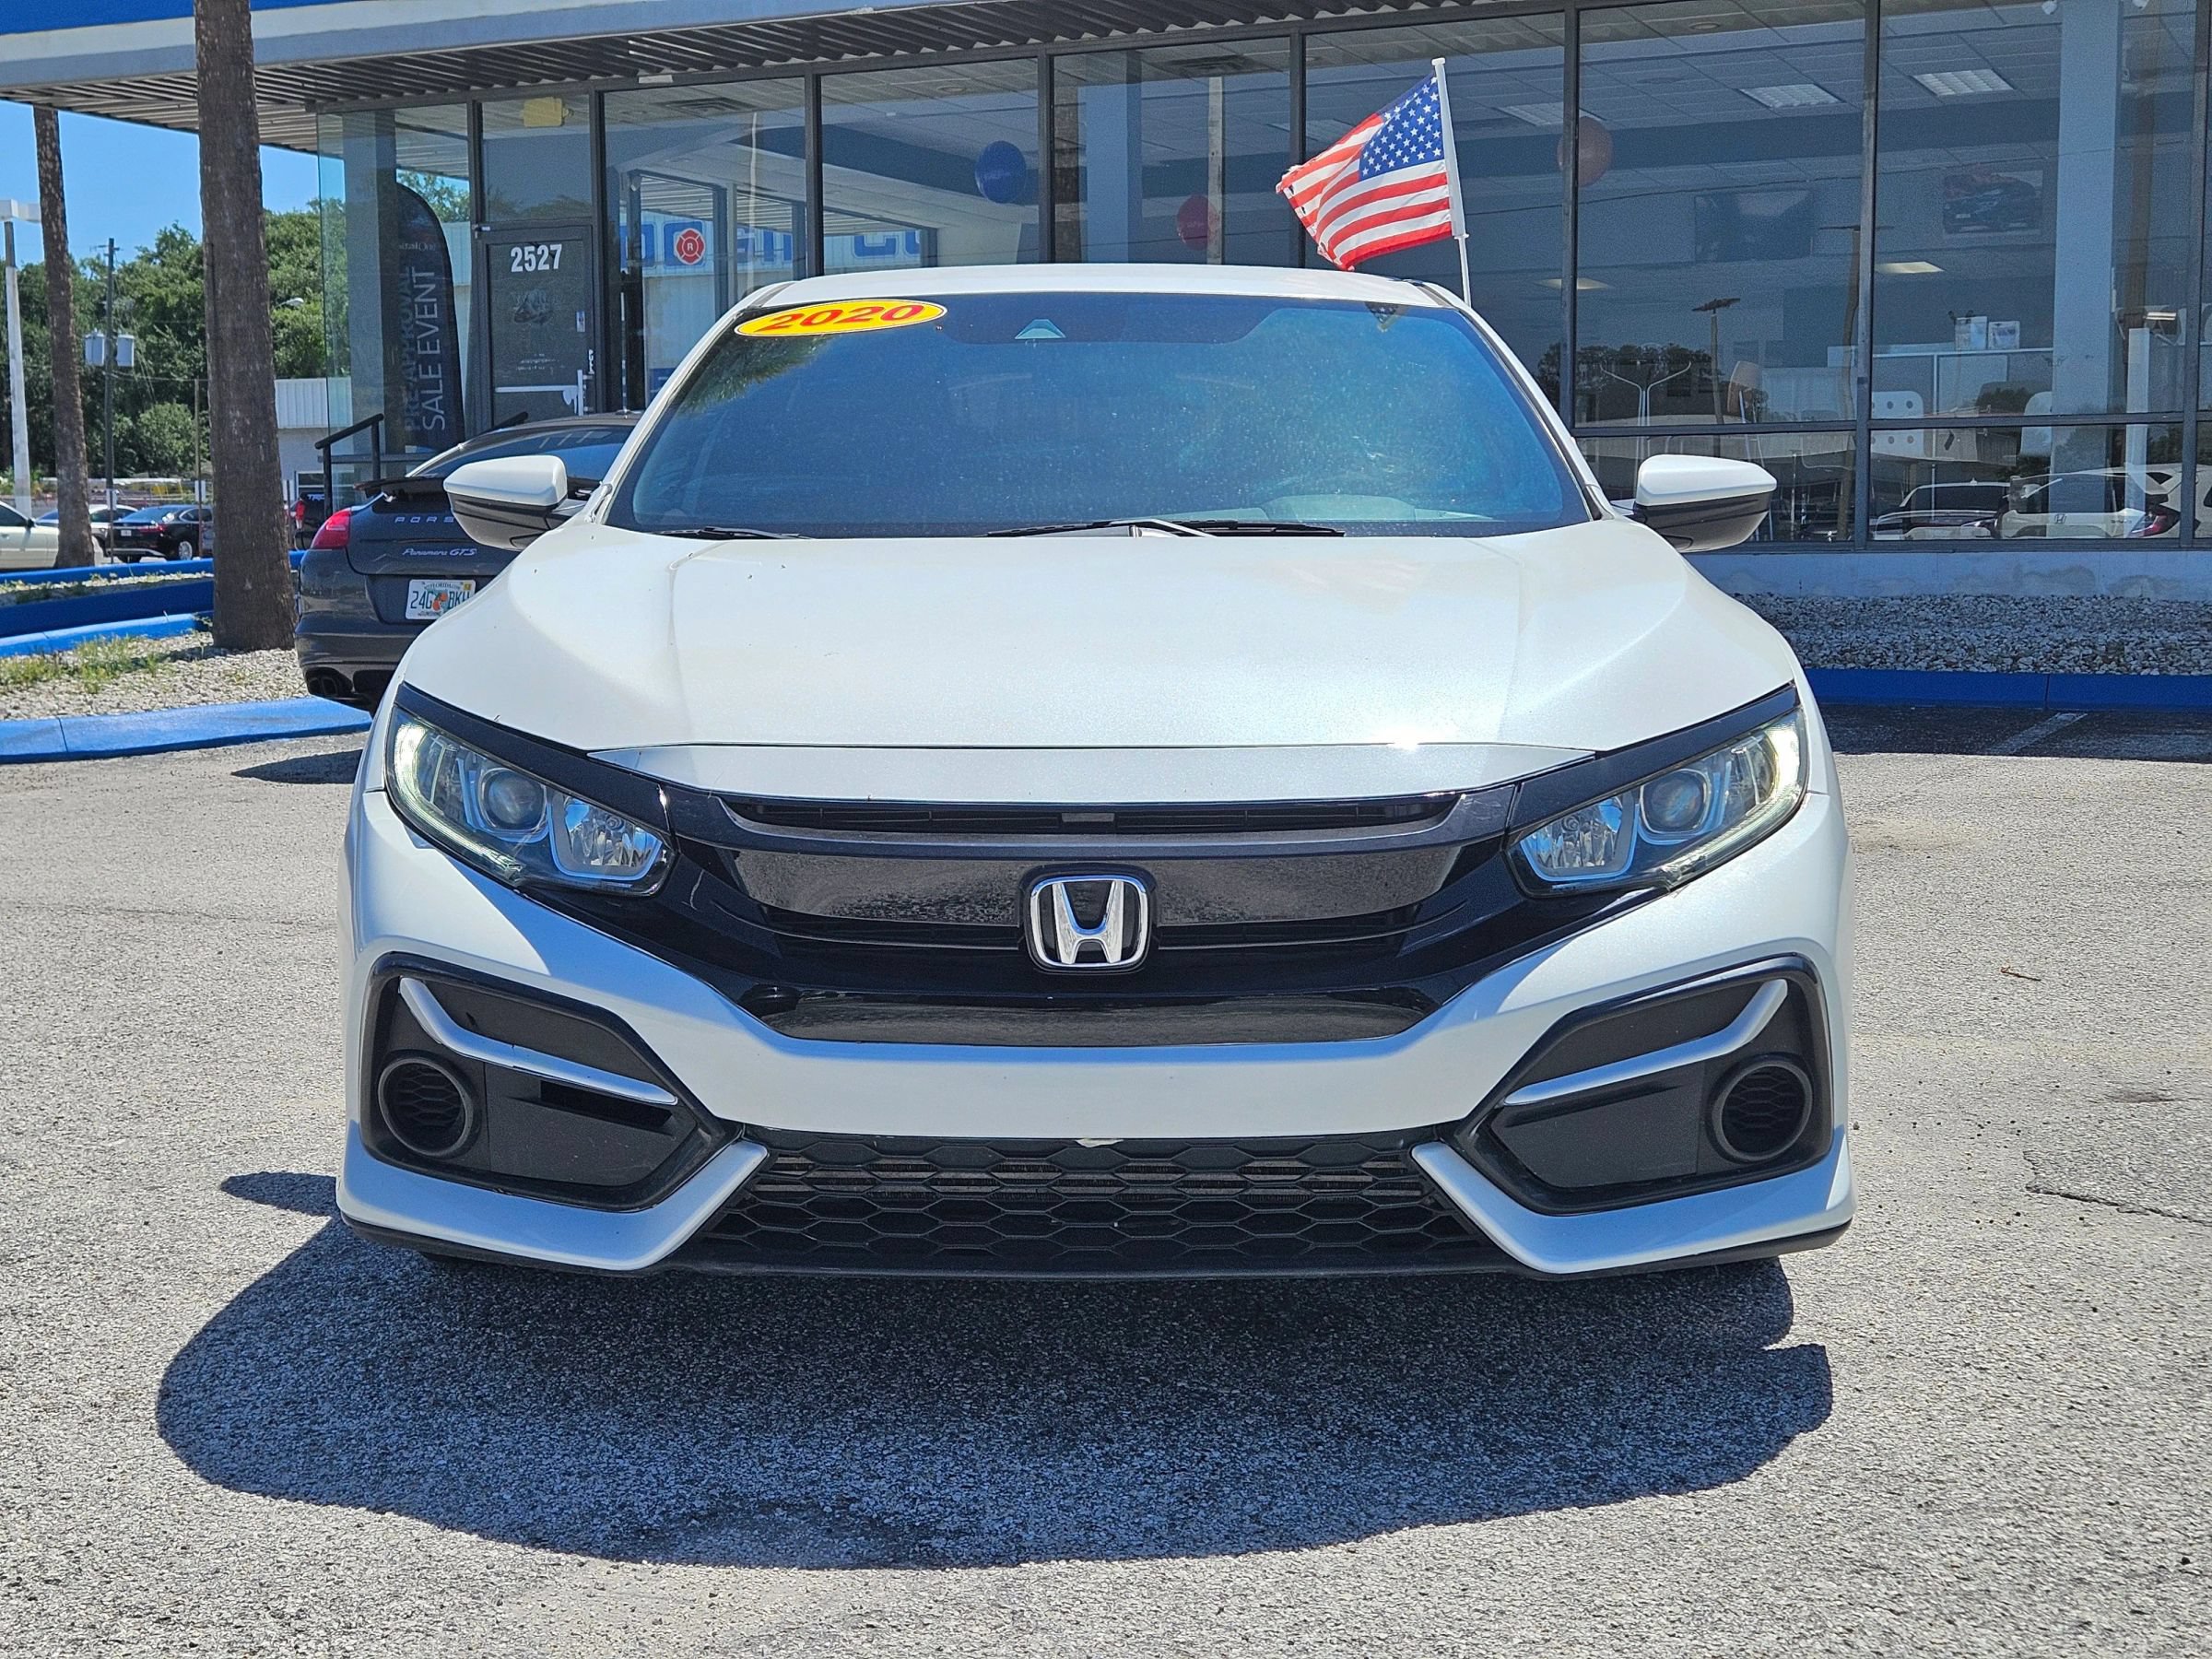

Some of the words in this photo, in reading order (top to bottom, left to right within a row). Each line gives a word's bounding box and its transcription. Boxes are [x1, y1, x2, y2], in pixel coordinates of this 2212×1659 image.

[511, 244, 562, 272] 2527
[687, 242, 694, 251] R
[413, 265, 441, 355] EVENT
[753, 305, 924, 332] 2020
[419, 363, 445, 430] SALE
[402, 547, 448, 556] Panamera
